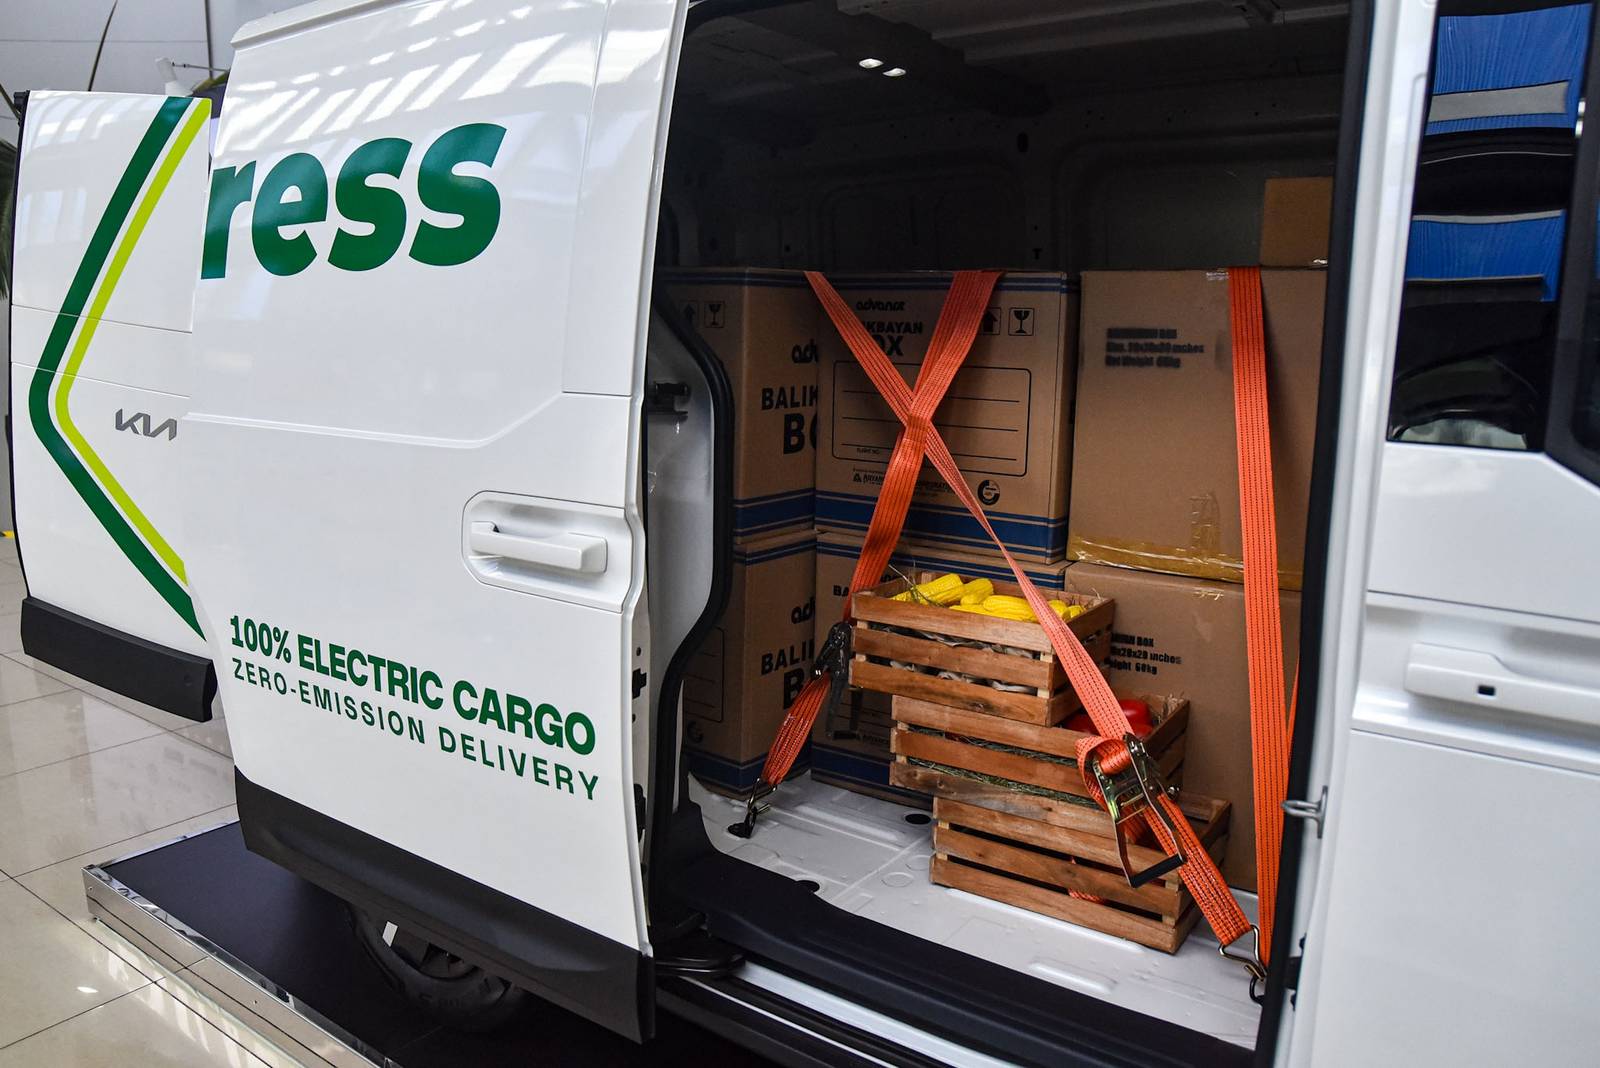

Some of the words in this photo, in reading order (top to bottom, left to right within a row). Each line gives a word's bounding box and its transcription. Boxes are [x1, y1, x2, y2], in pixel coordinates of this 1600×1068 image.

[200, 122, 507, 280] ress
[115, 408, 178, 441] KIA
[230, 615, 292, 664] 100%
[298, 634, 444, 711] ELECTRIC
[453, 681, 597, 756] CARGO
[232, 657, 426, 744] ZERO-EMISSION
[438, 726, 600, 801] DELIVERY
